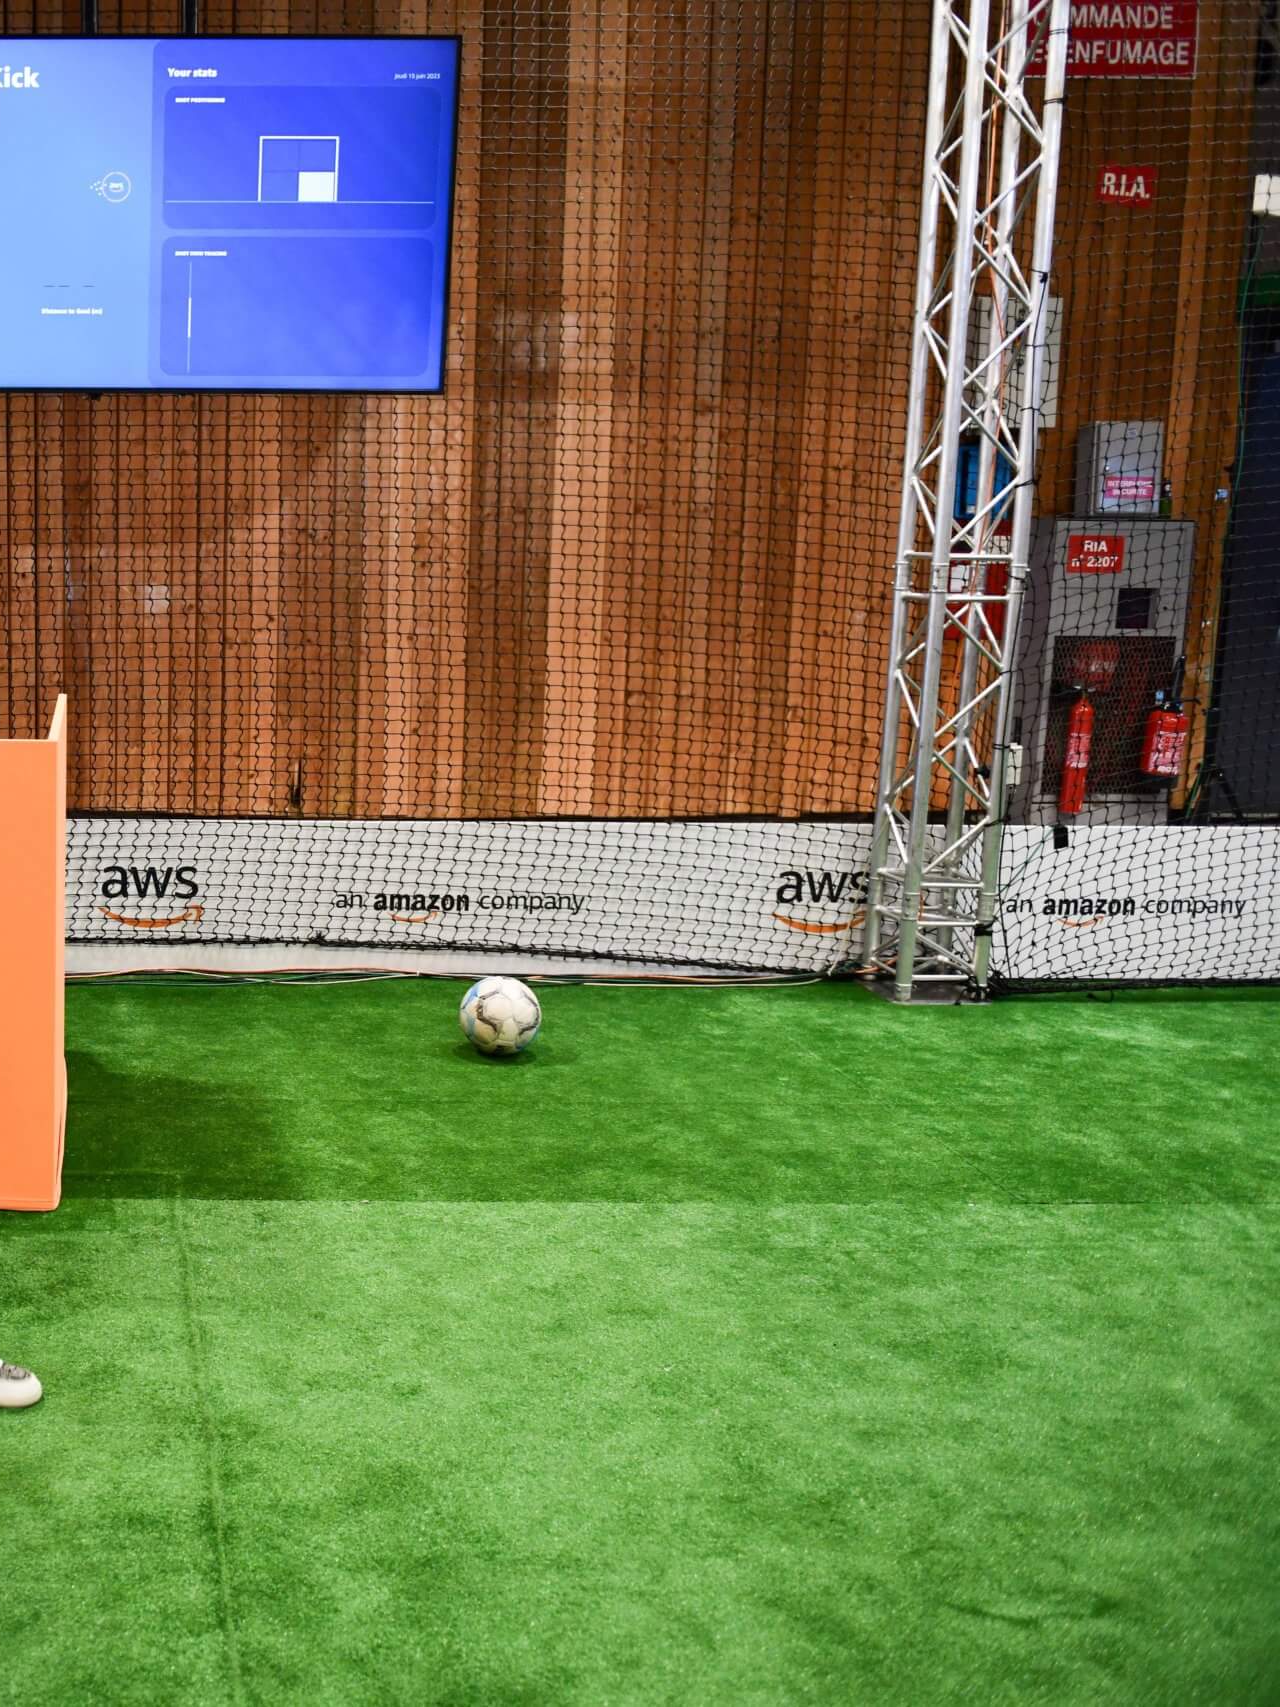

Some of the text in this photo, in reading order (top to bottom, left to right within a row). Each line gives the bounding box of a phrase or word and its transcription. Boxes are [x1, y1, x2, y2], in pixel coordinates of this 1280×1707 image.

[1032, 4, 1174, 30] MMANDE
[167, 67, 218, 78] Your stats
[1101, 172, 1151, 199] R.I.A.
[1083, 540, 1108, 552] RIA
[101, 865, 199, 899] aws
[776, 870, 870, 904] aws
[335, 892, 586, 916] an amazon company
[1006, 897, 1247, 919] an amazon company
